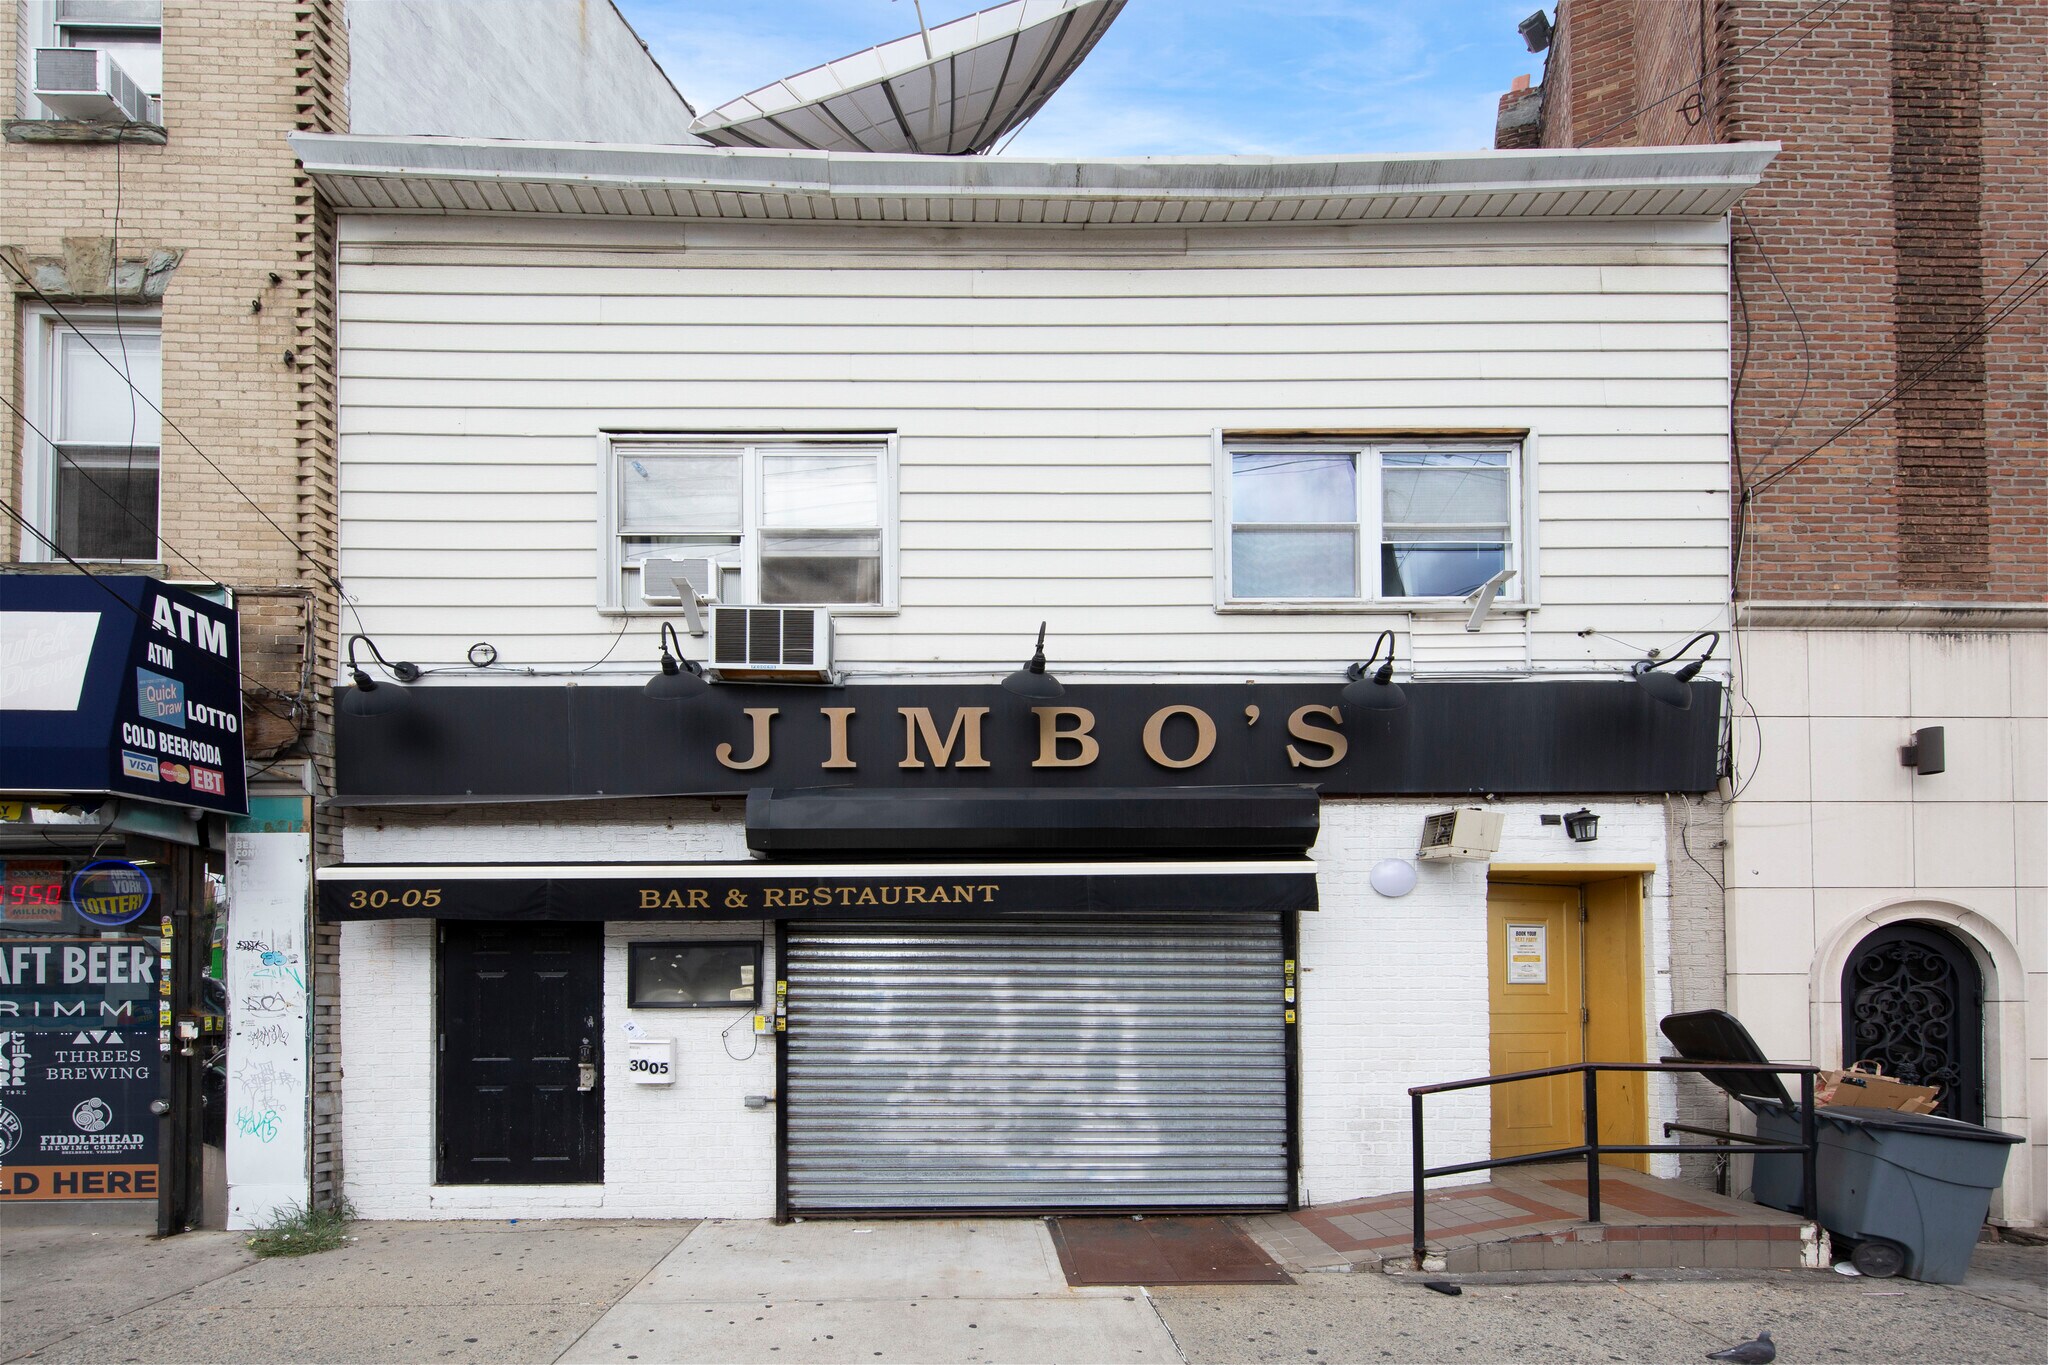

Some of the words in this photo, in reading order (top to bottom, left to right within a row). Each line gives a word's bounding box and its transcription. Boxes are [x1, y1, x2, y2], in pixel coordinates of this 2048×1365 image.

[152, 594, 228, 658] ATM
[147, 641, 173, 670] ATM
[146, 683, 177, 702] Quick
[158, 702, 182, 716] Draw
[187, 700, 237, 733] LOTTO
[122, 722, 156, 750] COLD
[159, 731, 222, 766] BEER/SODA
[715, 704, 1349, 771] JIMBO'S
[129, 759, 154, 773] VISA
[193, 768, 222, 792] EBT
[111, 870, 135, 880] NEW
[11, 885, 62, 905] 950
[113, 880, 142, 894] YORK
[638, 889, 711, 909] BAR
[724, 888, 748, 908] &
[763, 884, 1000, 907] RESTAURANT
[81, 894, 144, 915] LOTTERY
[349, 889, 442, 909] 30-05
[63, 946, 154, 984] BEER
[12, 1031, 32, 1086] PROJECT
[55, 1050, 141, 1063] THREES
[630, 1059, 669, 1074] 3005
[46, 1067, 150, 1080] BREWING
[40, 1134, 144, 1145] FIDDLEHEAD
[53, 1171, 157, 1194] HERE
